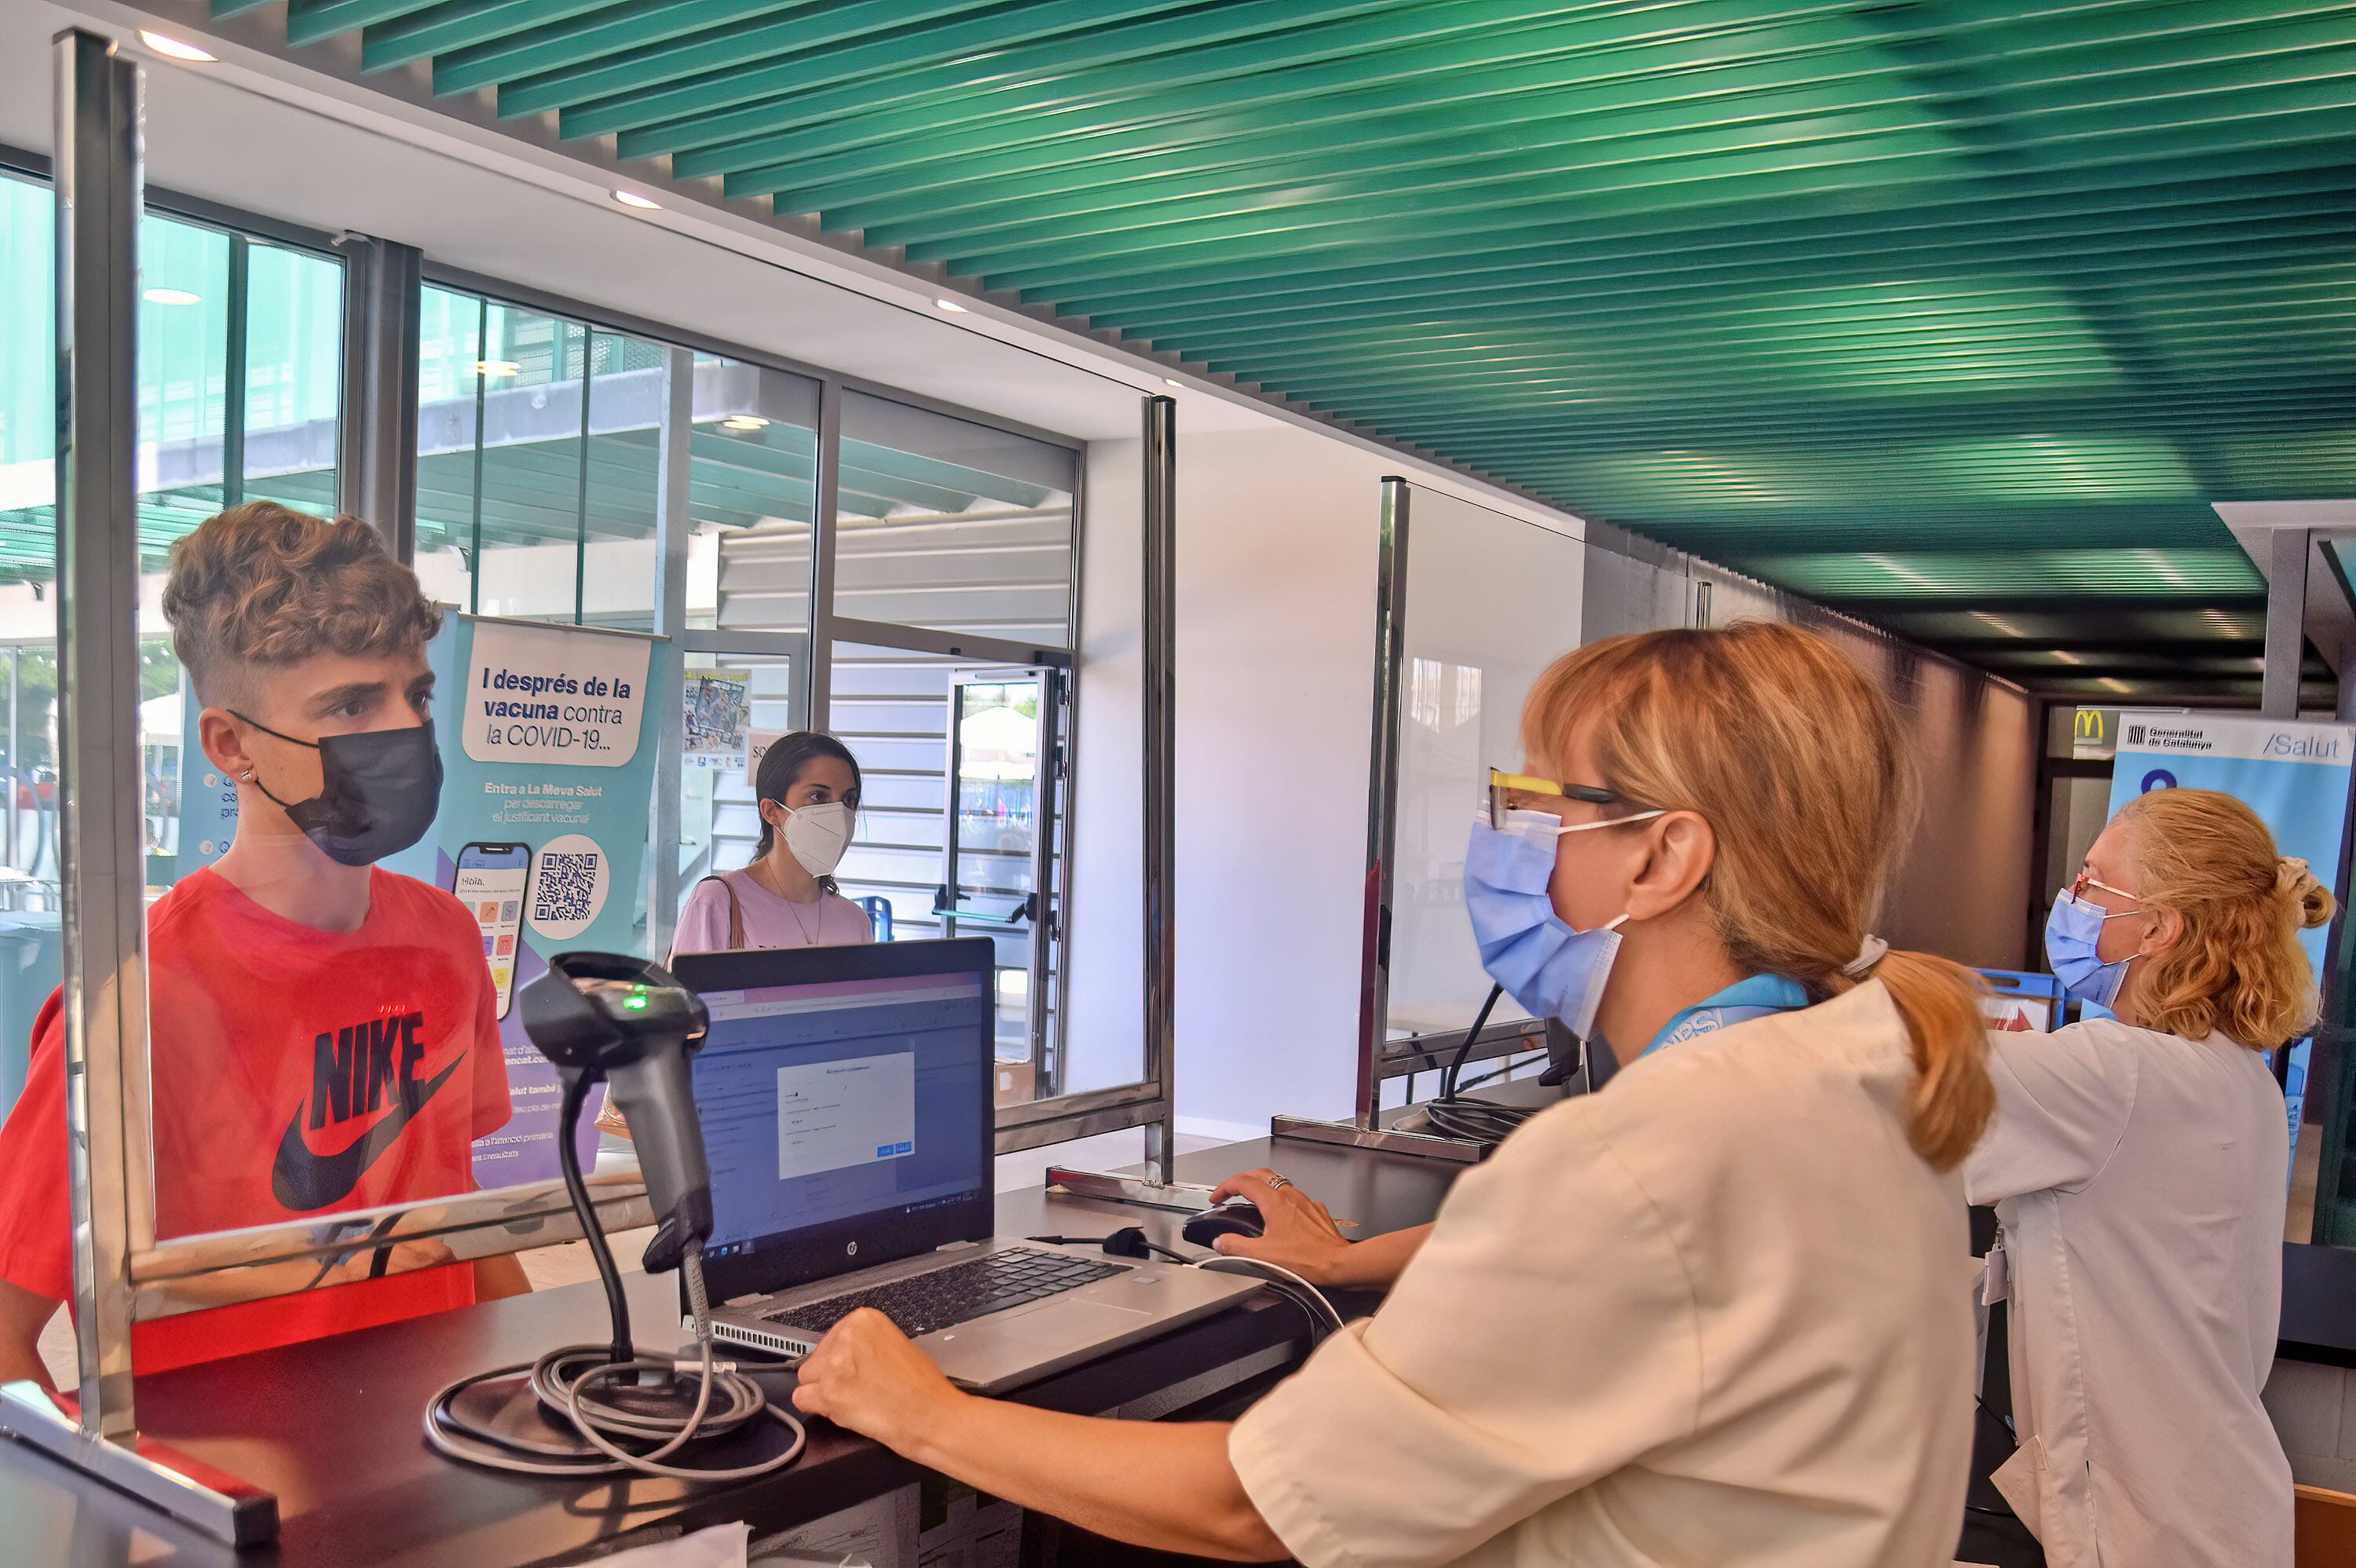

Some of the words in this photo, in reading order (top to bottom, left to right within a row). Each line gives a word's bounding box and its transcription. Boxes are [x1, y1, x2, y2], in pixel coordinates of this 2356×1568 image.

[482, 667, 490, 689] I
[493, 669, 579, 696] després
[584, 676, 609, 696] de
[613, 678, 631, 699] la
[484, 700, 559, 720] vacuna
[563, 705, 623, 725] contra
[486, 723, 503, 744] la
[507, 724, 610, 751] COVID-19...
[2149, 727, 2203, 740] Generalitat
[2149, 737, 2161, 747] de
[2163, 738, 2212, 751] Catalunya
[485, 782, 518, 795] Entra
[527, 783, 540, 795] La
[576, 785, 602, 797] Salut
[309, 1011, 425, 1131] NIKE
